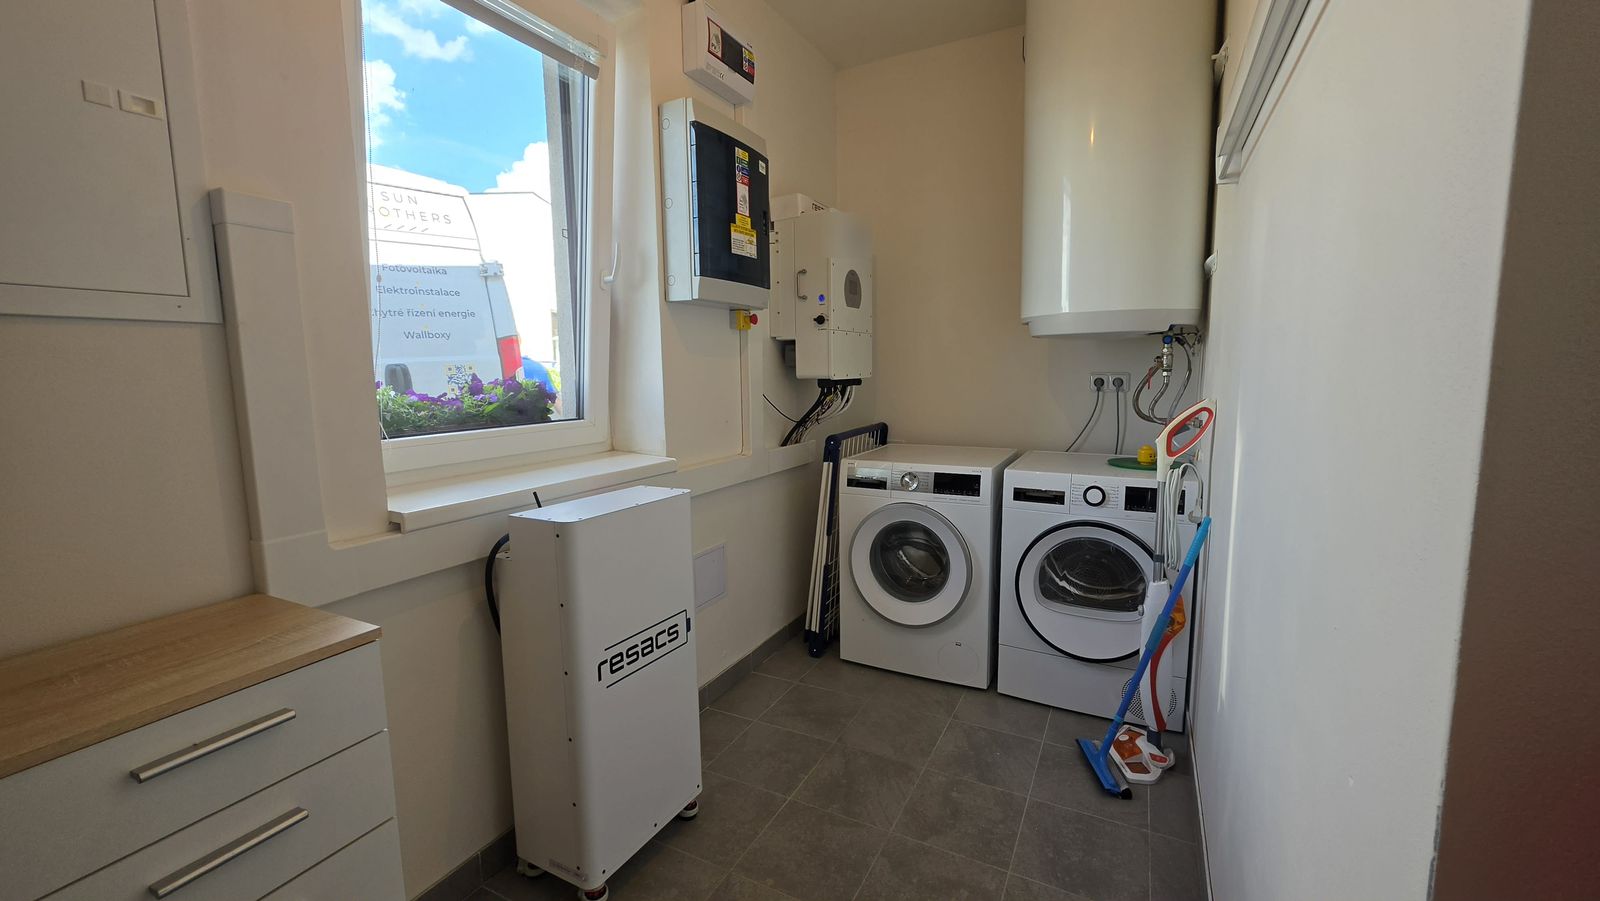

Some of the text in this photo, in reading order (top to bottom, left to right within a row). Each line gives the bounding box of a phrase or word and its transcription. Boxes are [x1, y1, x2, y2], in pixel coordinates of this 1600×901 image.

[380, 191, 418, 205] SUN
[368, 205, 452, 225] OTHERS
[382, 264, 448, 275] Fotovoltaika
[376, 285, 461, 297] Elektroinstalace
[371, 309, 404, 319] hytré
[438, 310, 476, 320] energie
[403, 331, 451, 341] Wallboxy
[597, 623, 680, 682] resacs
